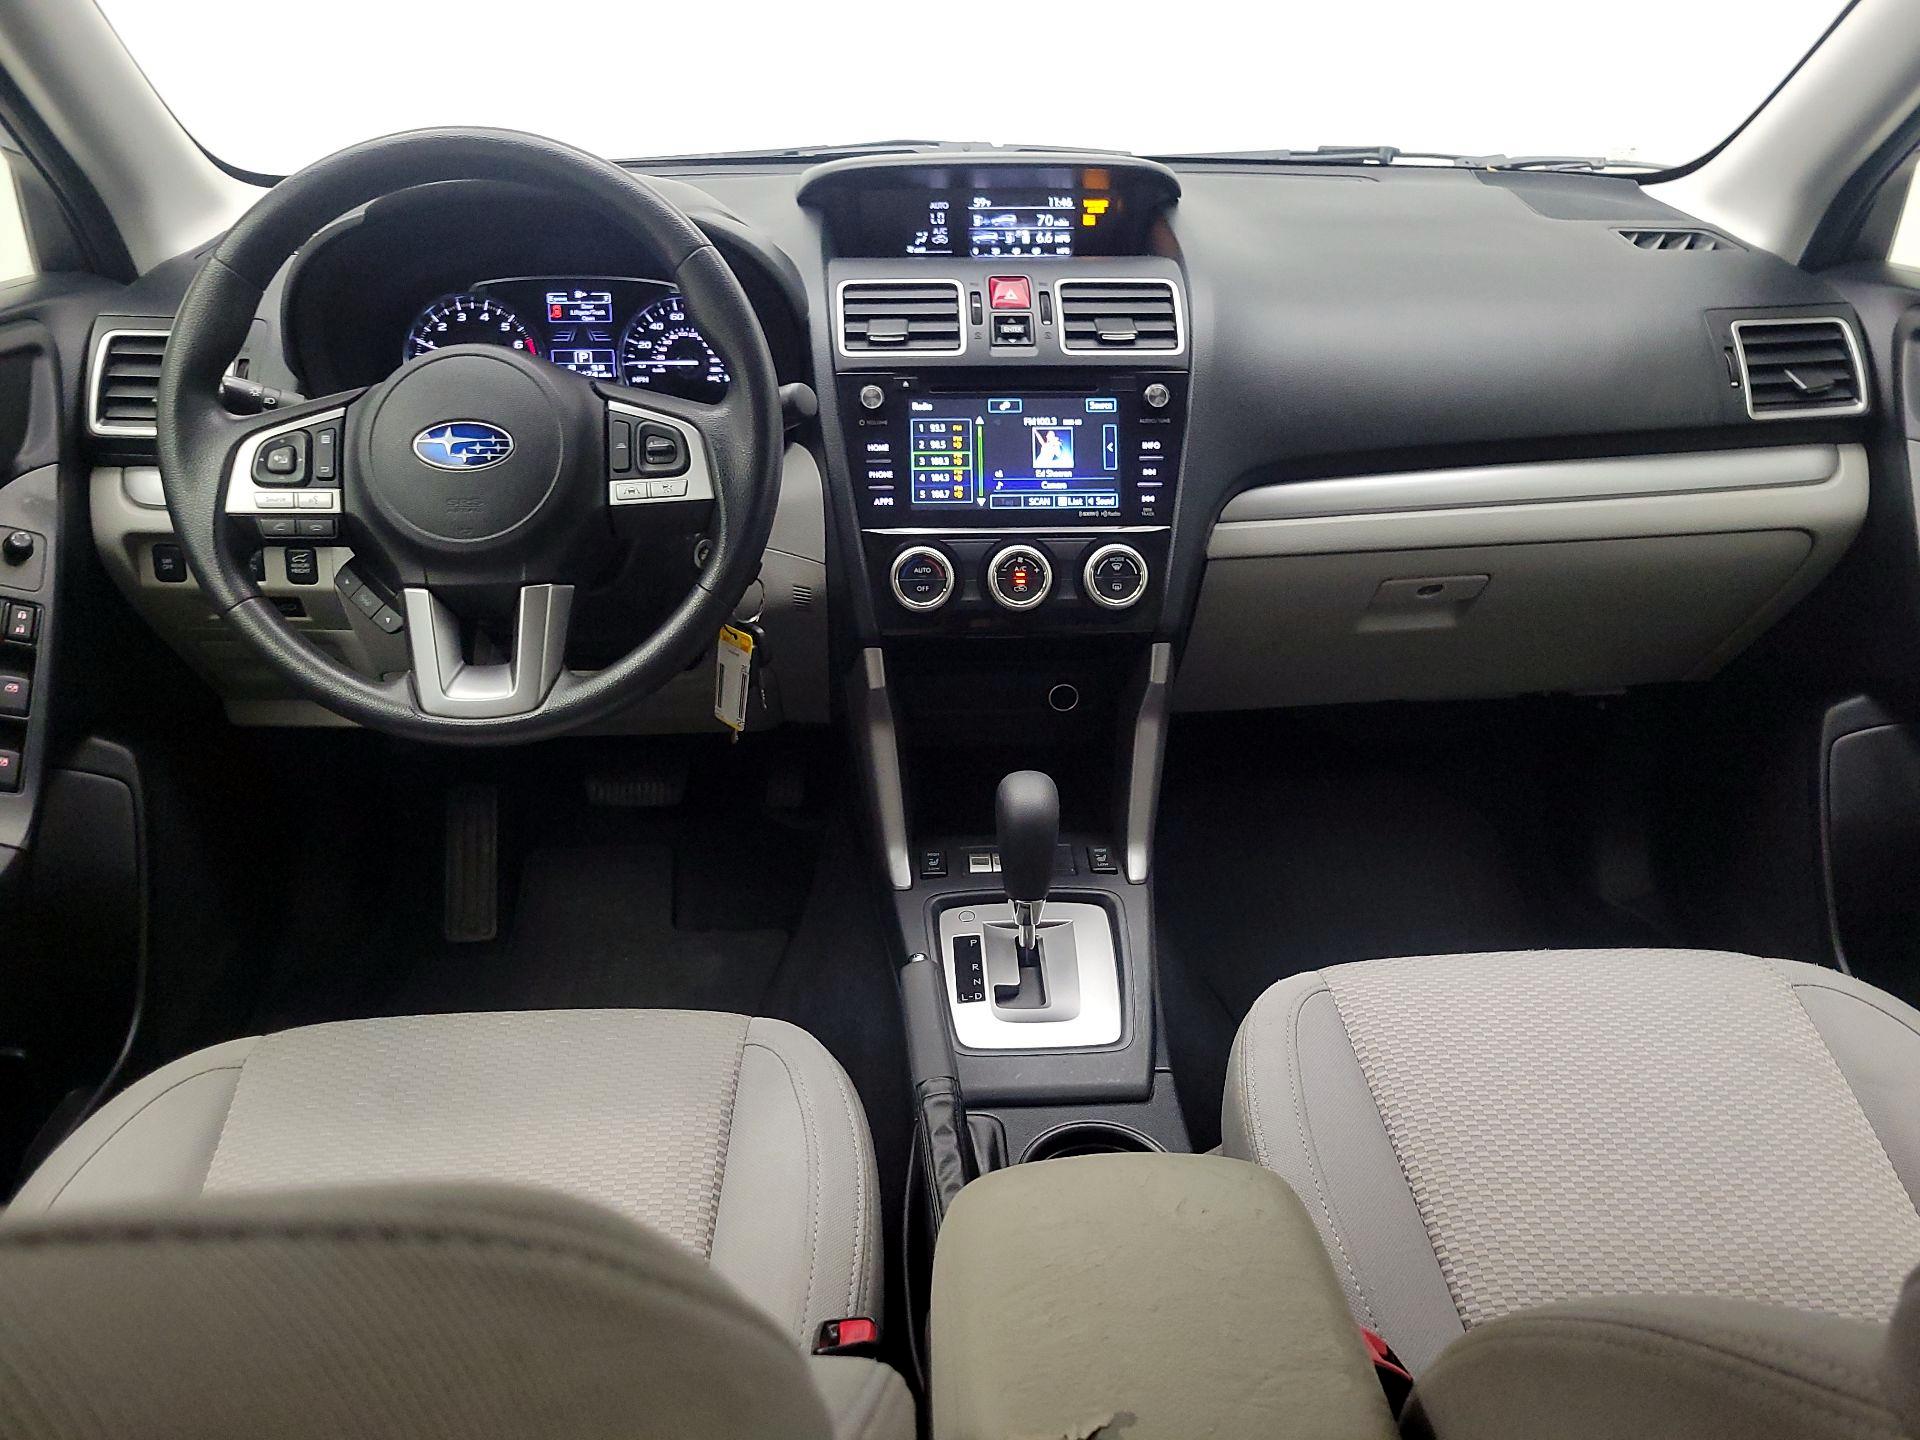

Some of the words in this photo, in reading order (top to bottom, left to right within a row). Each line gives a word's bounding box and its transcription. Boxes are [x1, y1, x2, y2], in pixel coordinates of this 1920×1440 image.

[1036, 214, 1053, 227] 70
[457, 313, 467, 321] 3
[480, 313, 490, 321] 4
[669, 313, 684, 321] 60
[437, 323, 447, 331] 2
[500, 322, 510, 331] 5
[649, 322, 664, 330] 40
[513, 341, 523, 349] 6
[638, 341, 652, 349] 20
[867, 444, 889, 452] HOME
[919, 440, 925, 449] 2
[1142, 441, 1161, 450] INFO
[919, 457, 925, 466] 3
[868, 471, 893, 479] PHONE
[919, 473, 926, 482] 4
[920, 490, 926, 498] 5
[874, 498, 894, 506] APPS
[1028, 497, 1051, 506] SCAN
[970, 939, 978, 947] P
[972, 963, 979, 971] R
